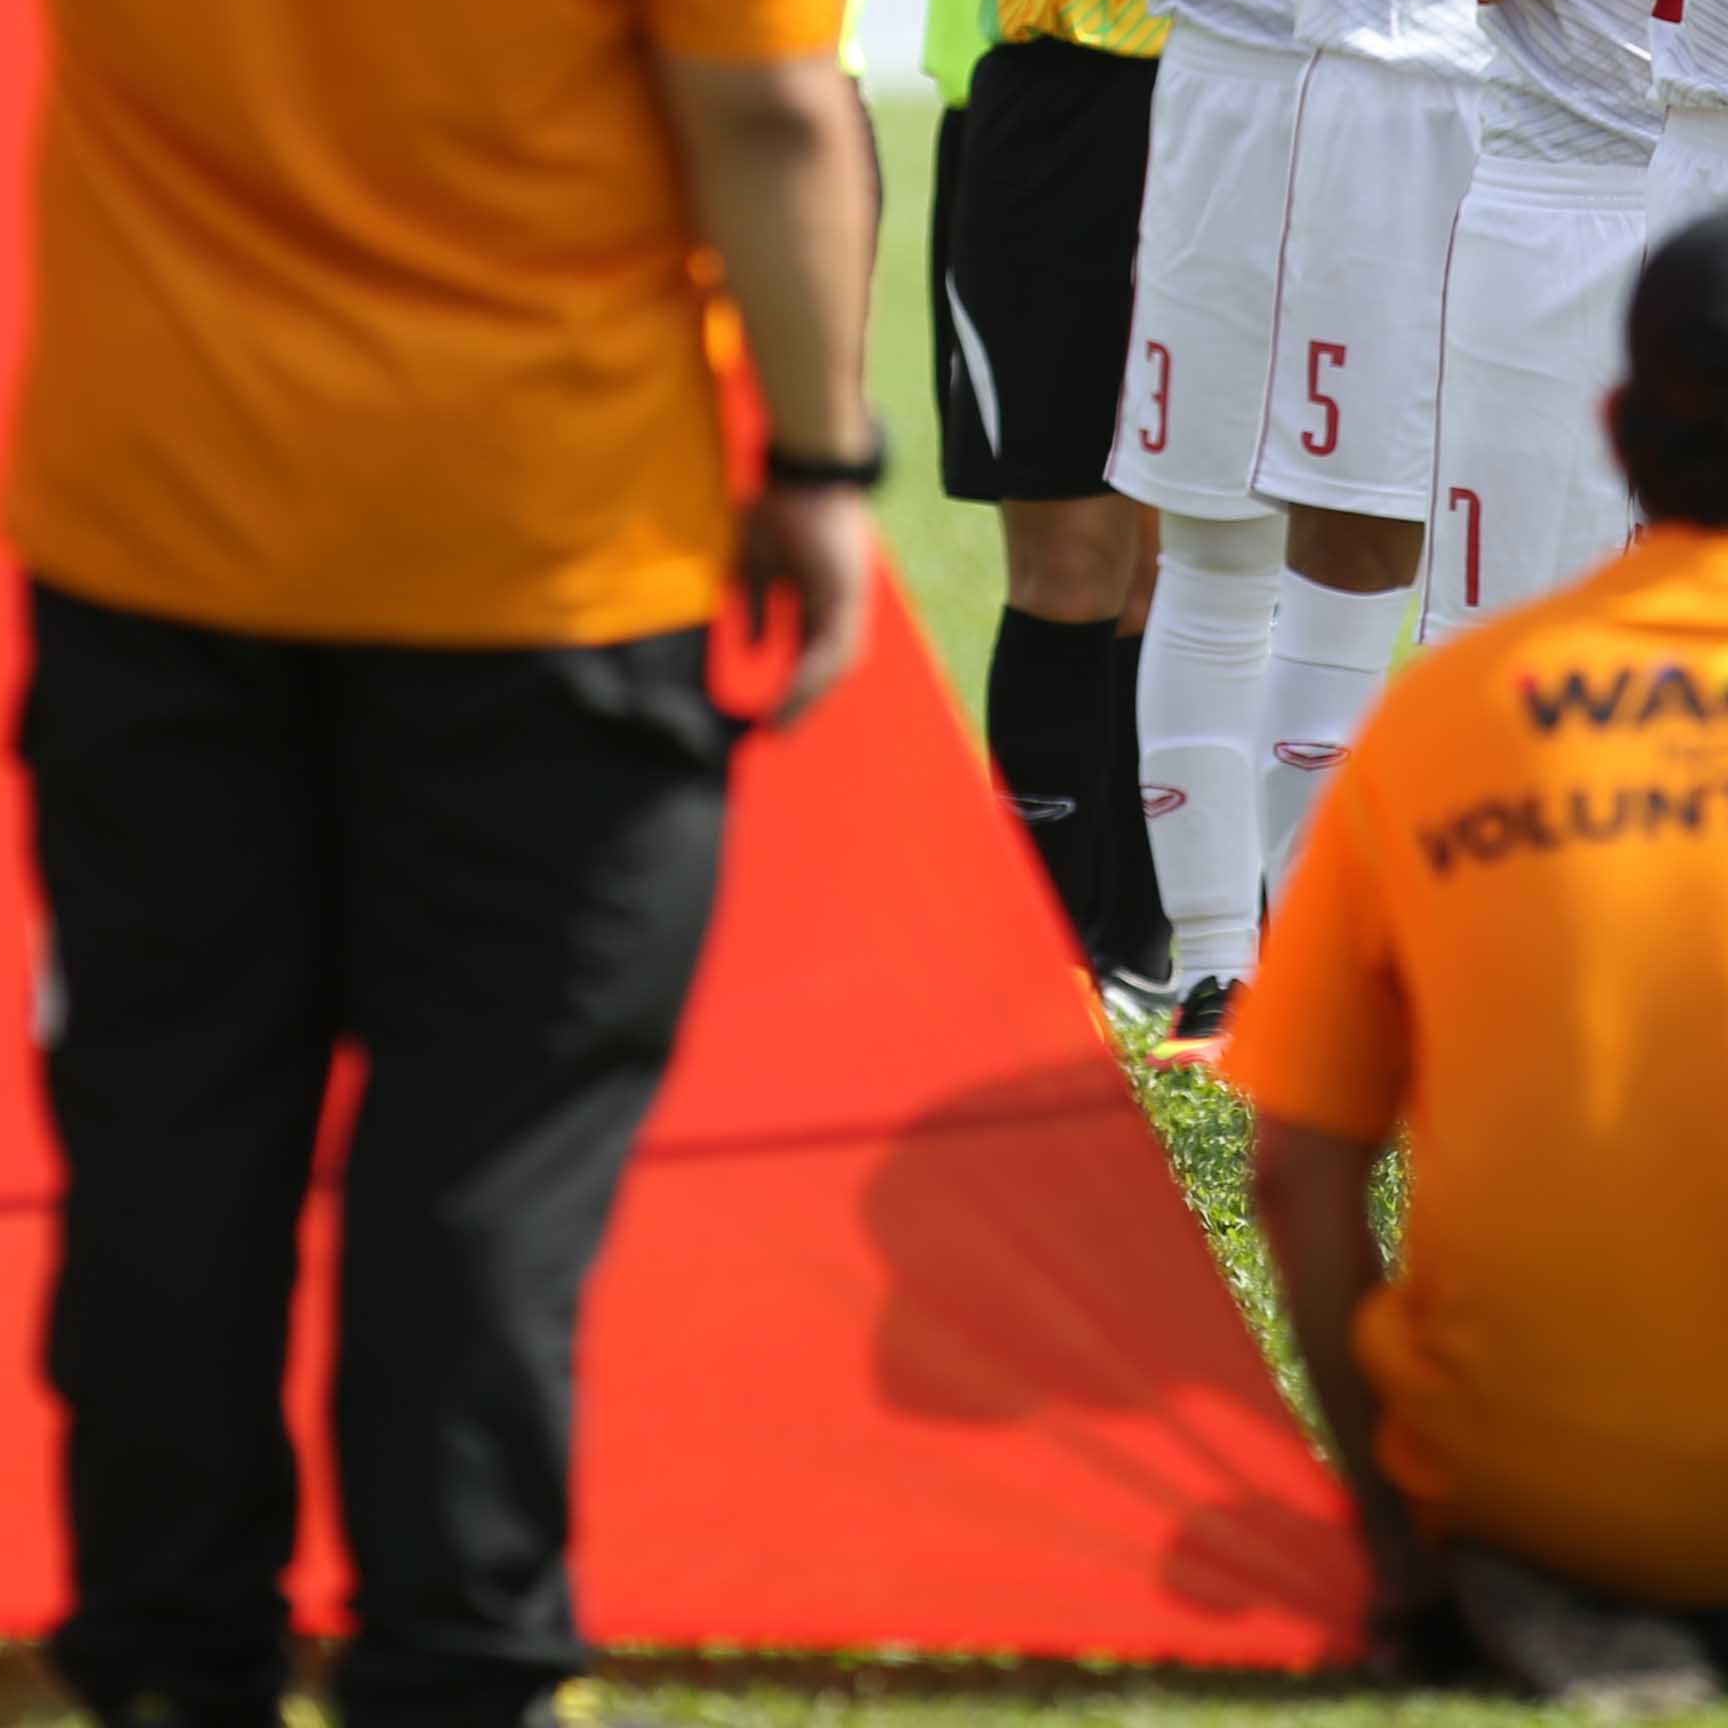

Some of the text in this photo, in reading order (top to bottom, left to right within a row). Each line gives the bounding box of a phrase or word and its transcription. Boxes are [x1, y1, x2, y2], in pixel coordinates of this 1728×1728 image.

[1140, 340, 1172, 454] 3
[1301, 340, 1347, 457] 5
[1449, 487, 1482, 608] 7
